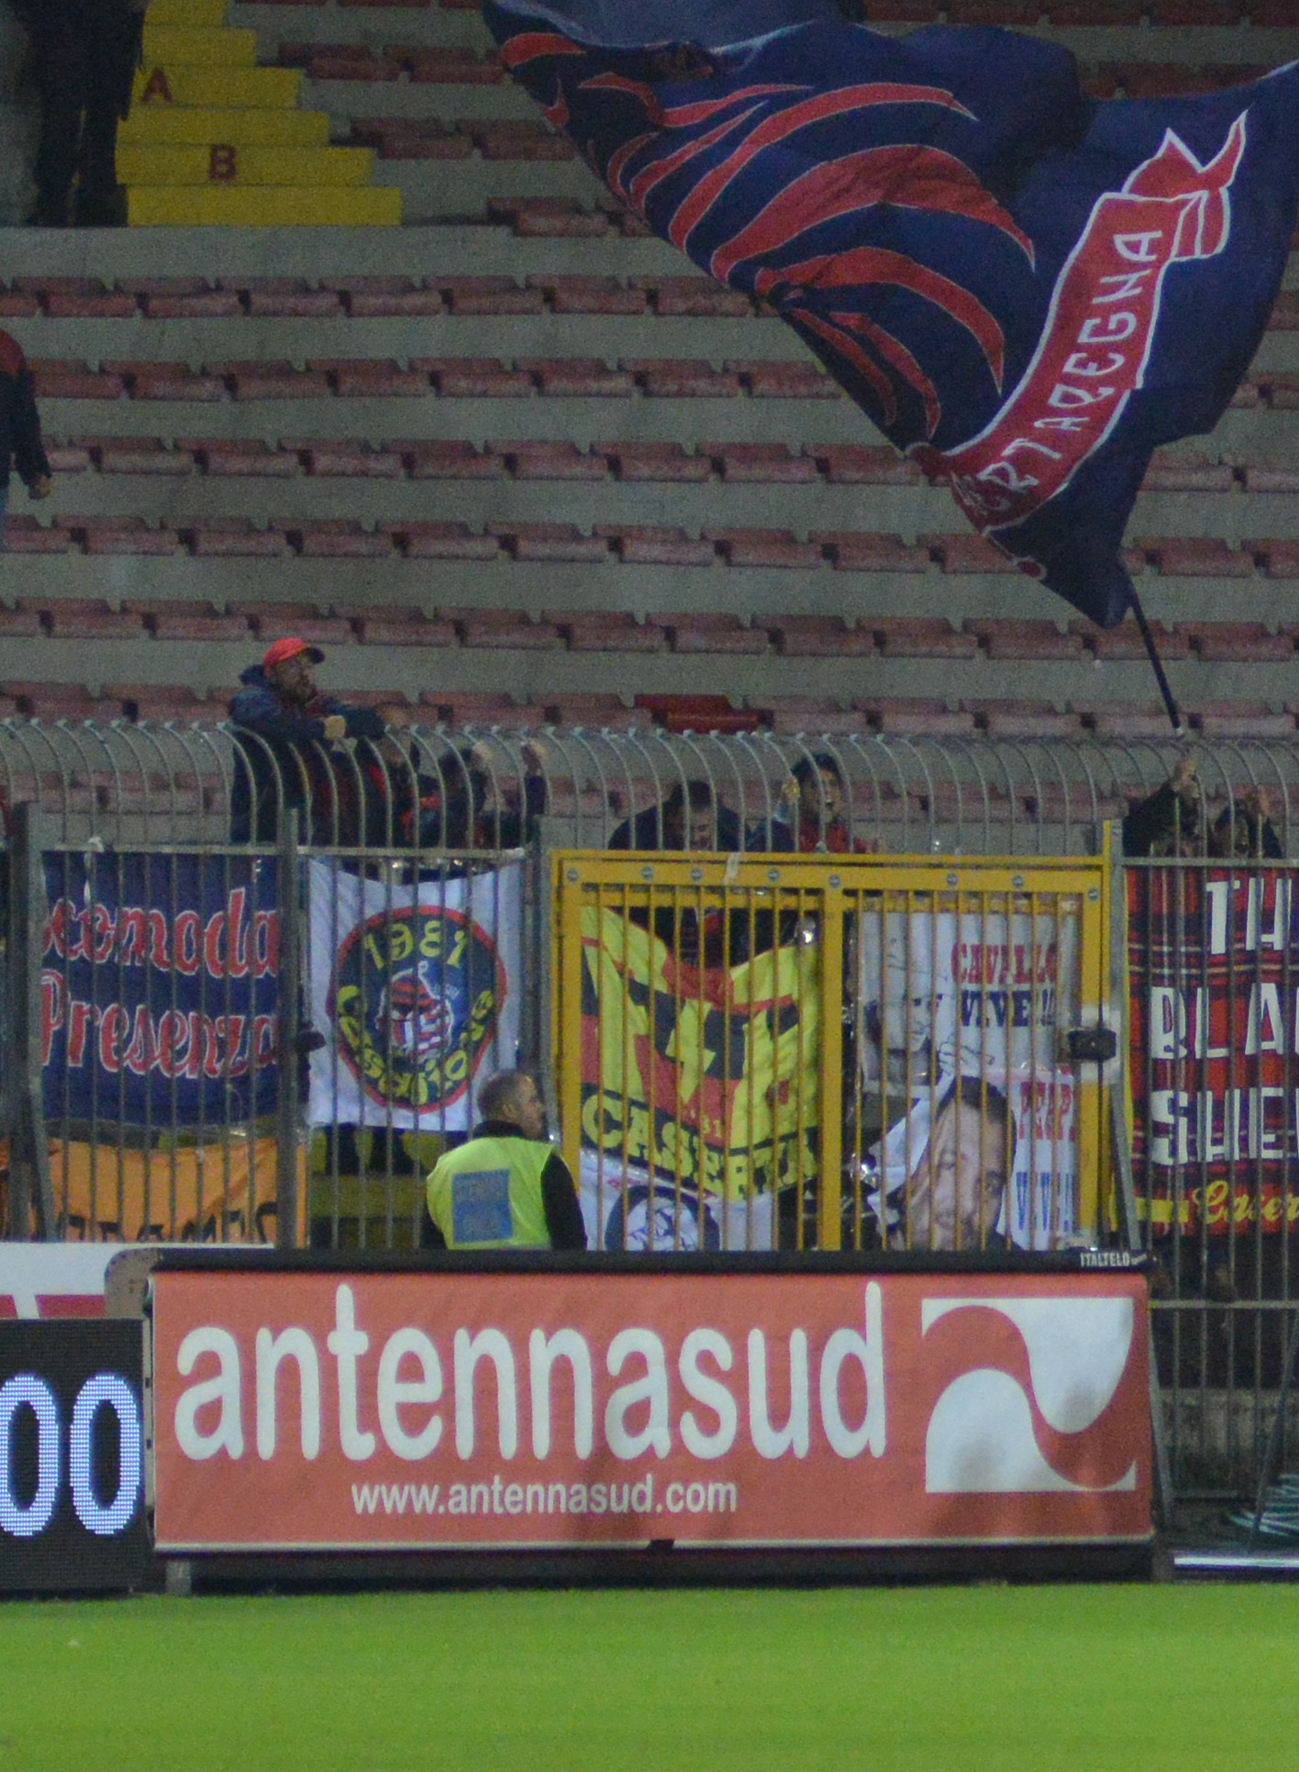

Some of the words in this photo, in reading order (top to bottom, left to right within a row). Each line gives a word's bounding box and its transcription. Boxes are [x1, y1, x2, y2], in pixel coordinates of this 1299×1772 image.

[141, 67, 173, 102] A
[208, 144, 237, 182] B
[174, 1281, 887, 1461] antennasud
[351, 1473, 737, 1516] www.antennasud.com
